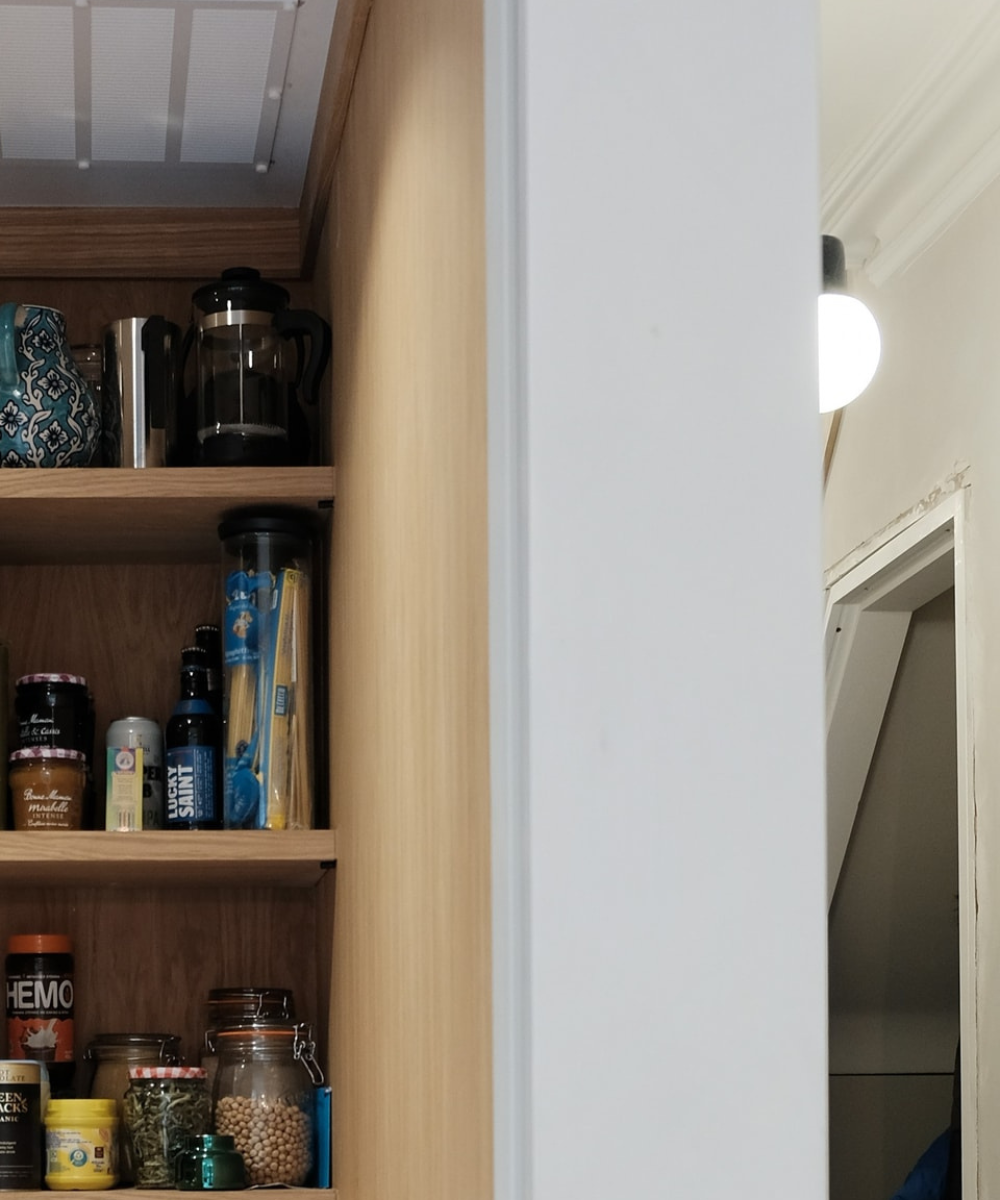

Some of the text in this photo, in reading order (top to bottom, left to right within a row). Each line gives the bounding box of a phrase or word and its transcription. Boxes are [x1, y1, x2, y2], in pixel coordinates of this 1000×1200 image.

[23, 788, 72, 801] Bonne Maman
[167, 766, 178, 819] LUCKY
[178, 764, 194, 818] SAINT
[6, 979, 74, 1009] HEMO
